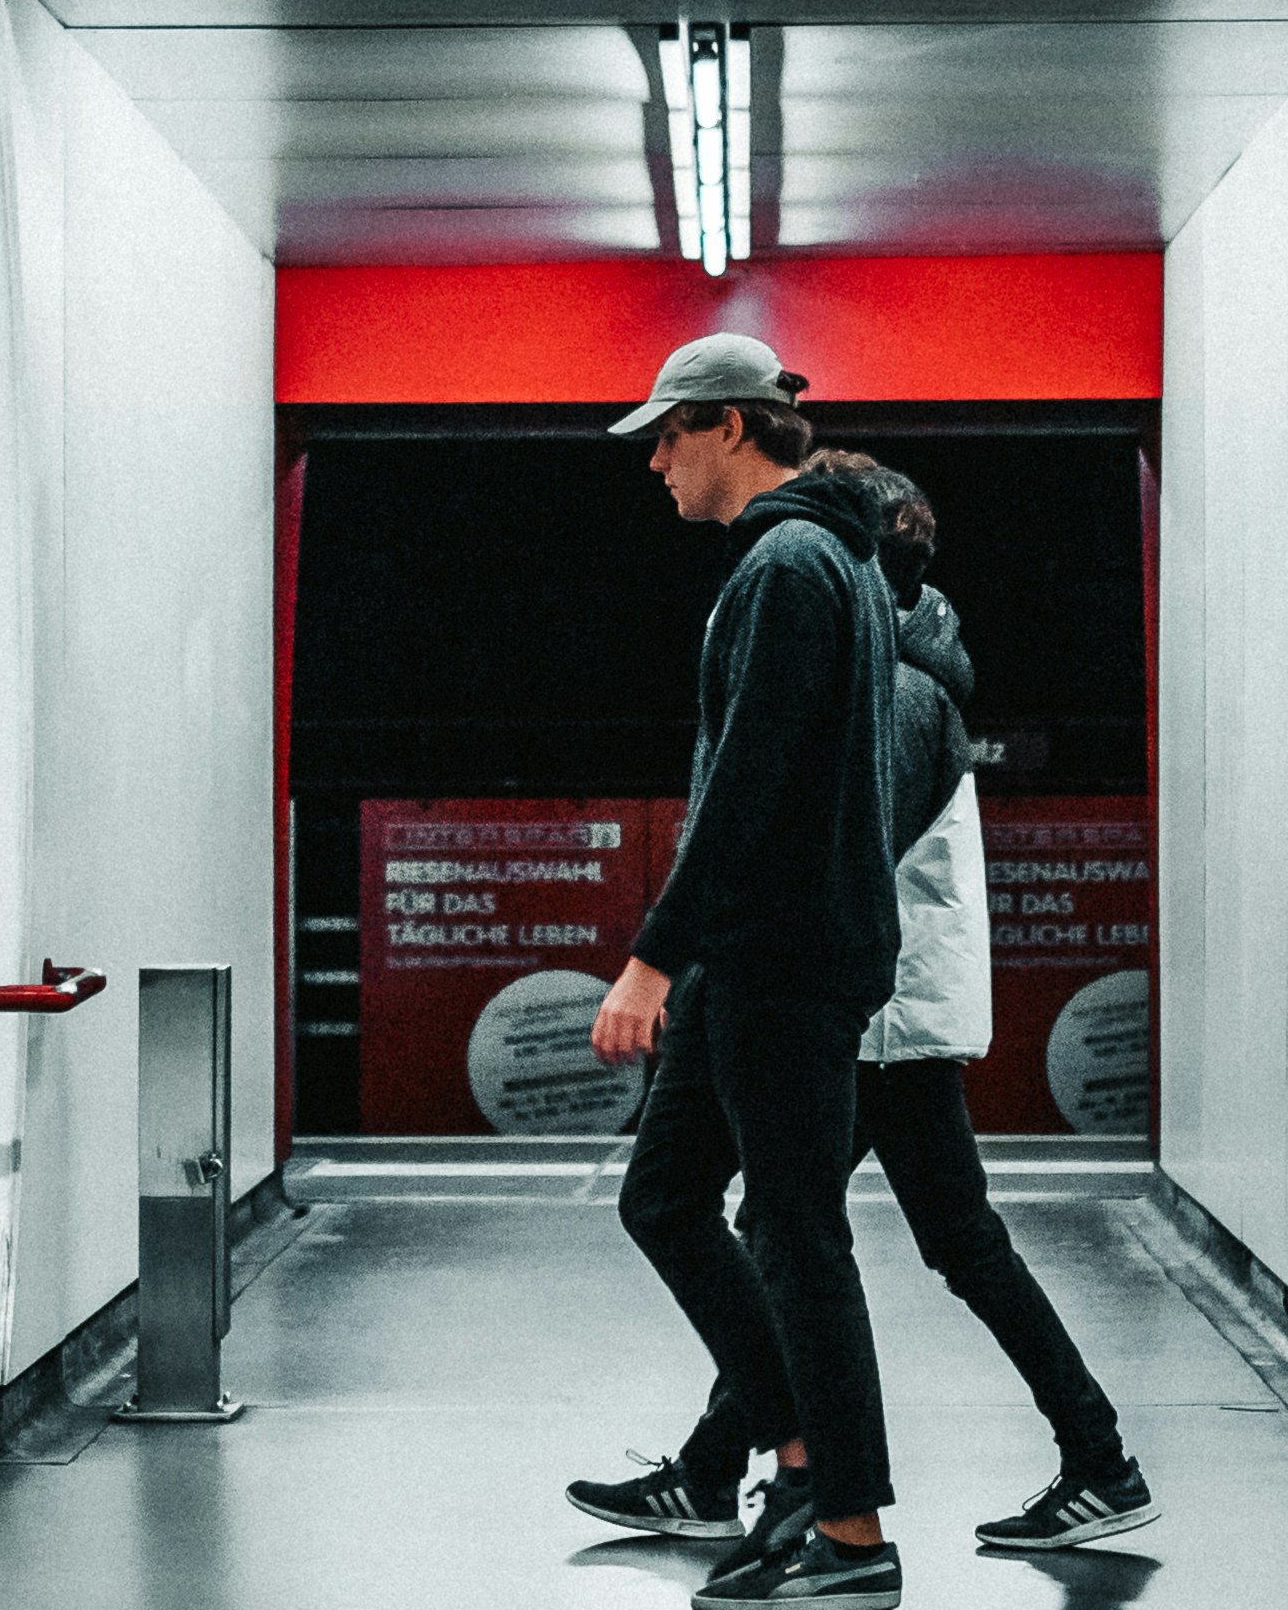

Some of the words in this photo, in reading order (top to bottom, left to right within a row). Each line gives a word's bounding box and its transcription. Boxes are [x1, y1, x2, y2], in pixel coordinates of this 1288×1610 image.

[386, 861, 603, 883] RIESENAUSWAHL
[988, 861, 1149, 882] ESENAUSWA
[386, 889, 435, 914] FÜR
[444, 893, 496, 914] DAS
[1021, 893, 1074, 914] DAS
[387, 920, 509, 945] TÄGLICHE
[518, 925, 598, 945] LEBEN
[993, 924, 1088, 945] GLICHE
